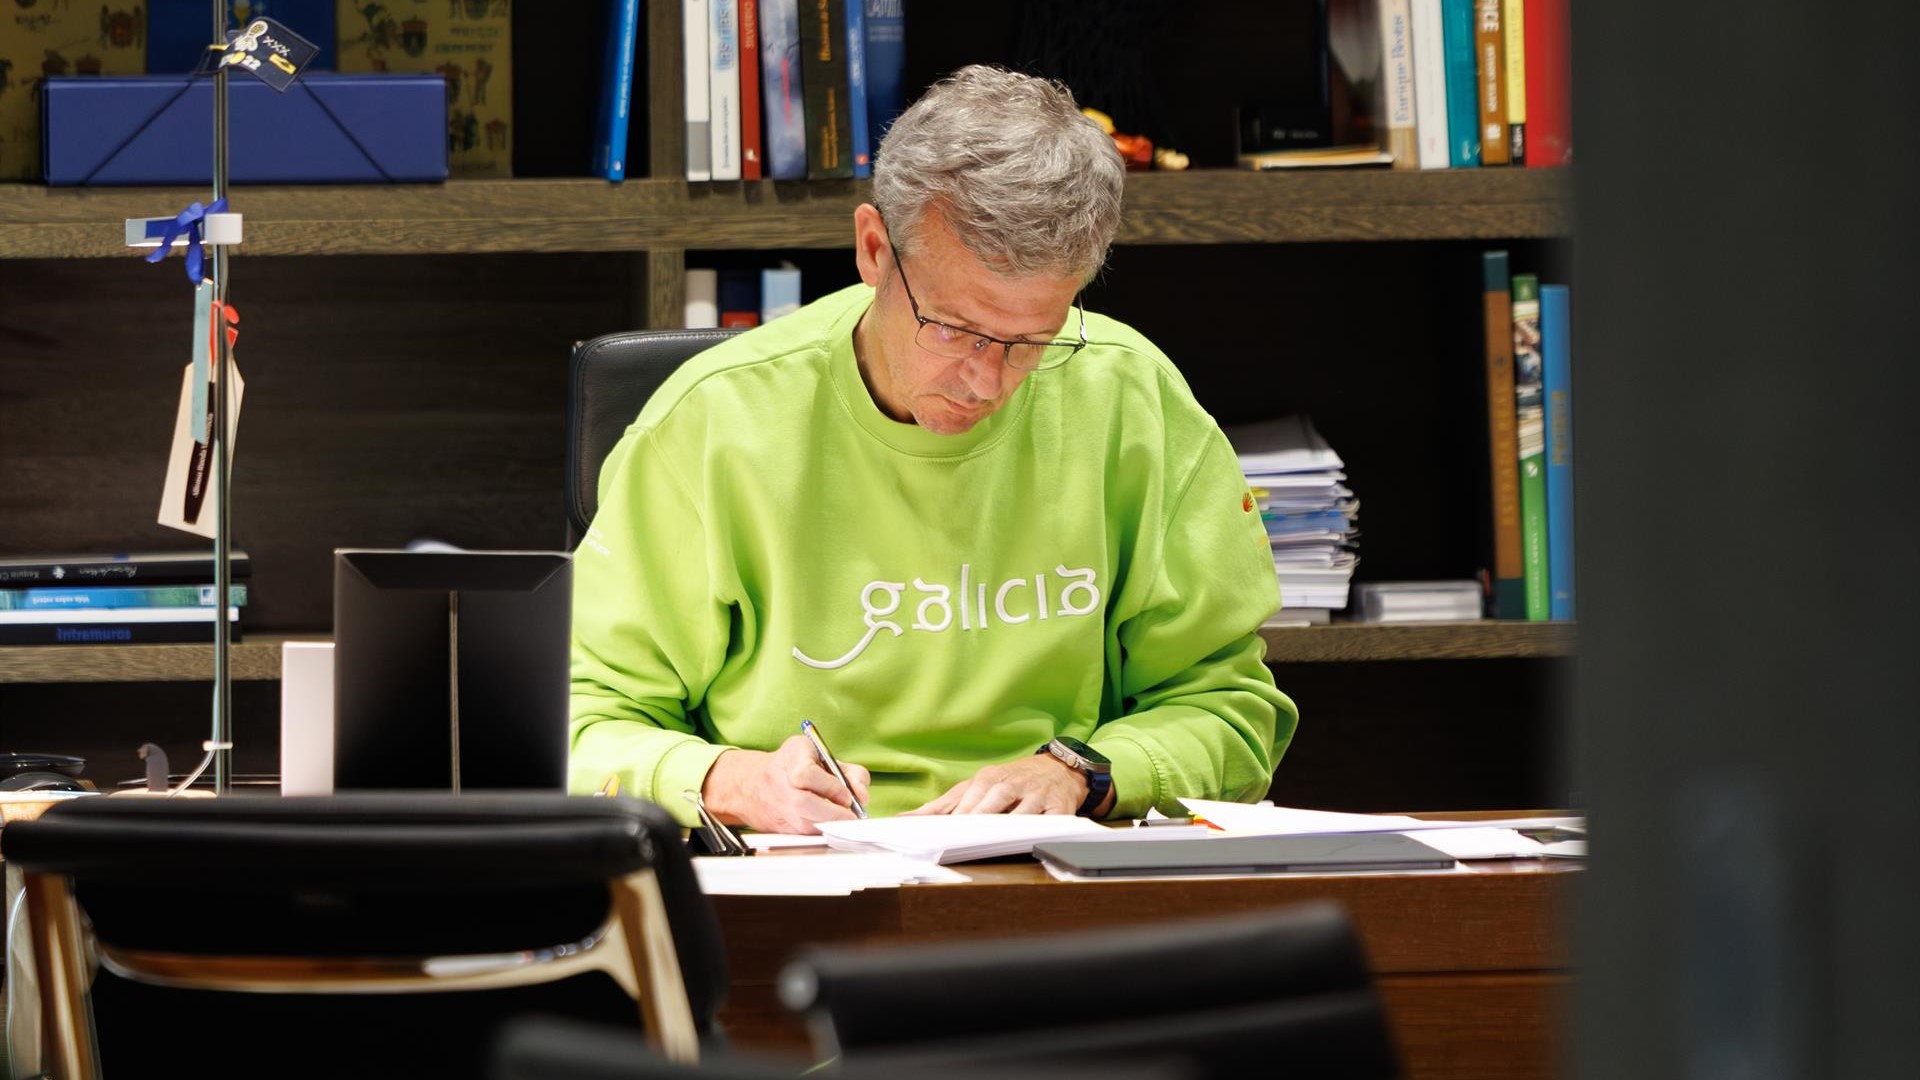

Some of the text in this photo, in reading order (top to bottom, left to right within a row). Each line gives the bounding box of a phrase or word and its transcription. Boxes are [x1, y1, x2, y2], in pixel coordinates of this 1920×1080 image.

[744, 1, 756, 49] SILVERIO
[1393, 63, 1410, 122] Enrique
[792, 563, 1102, 671] galicia
